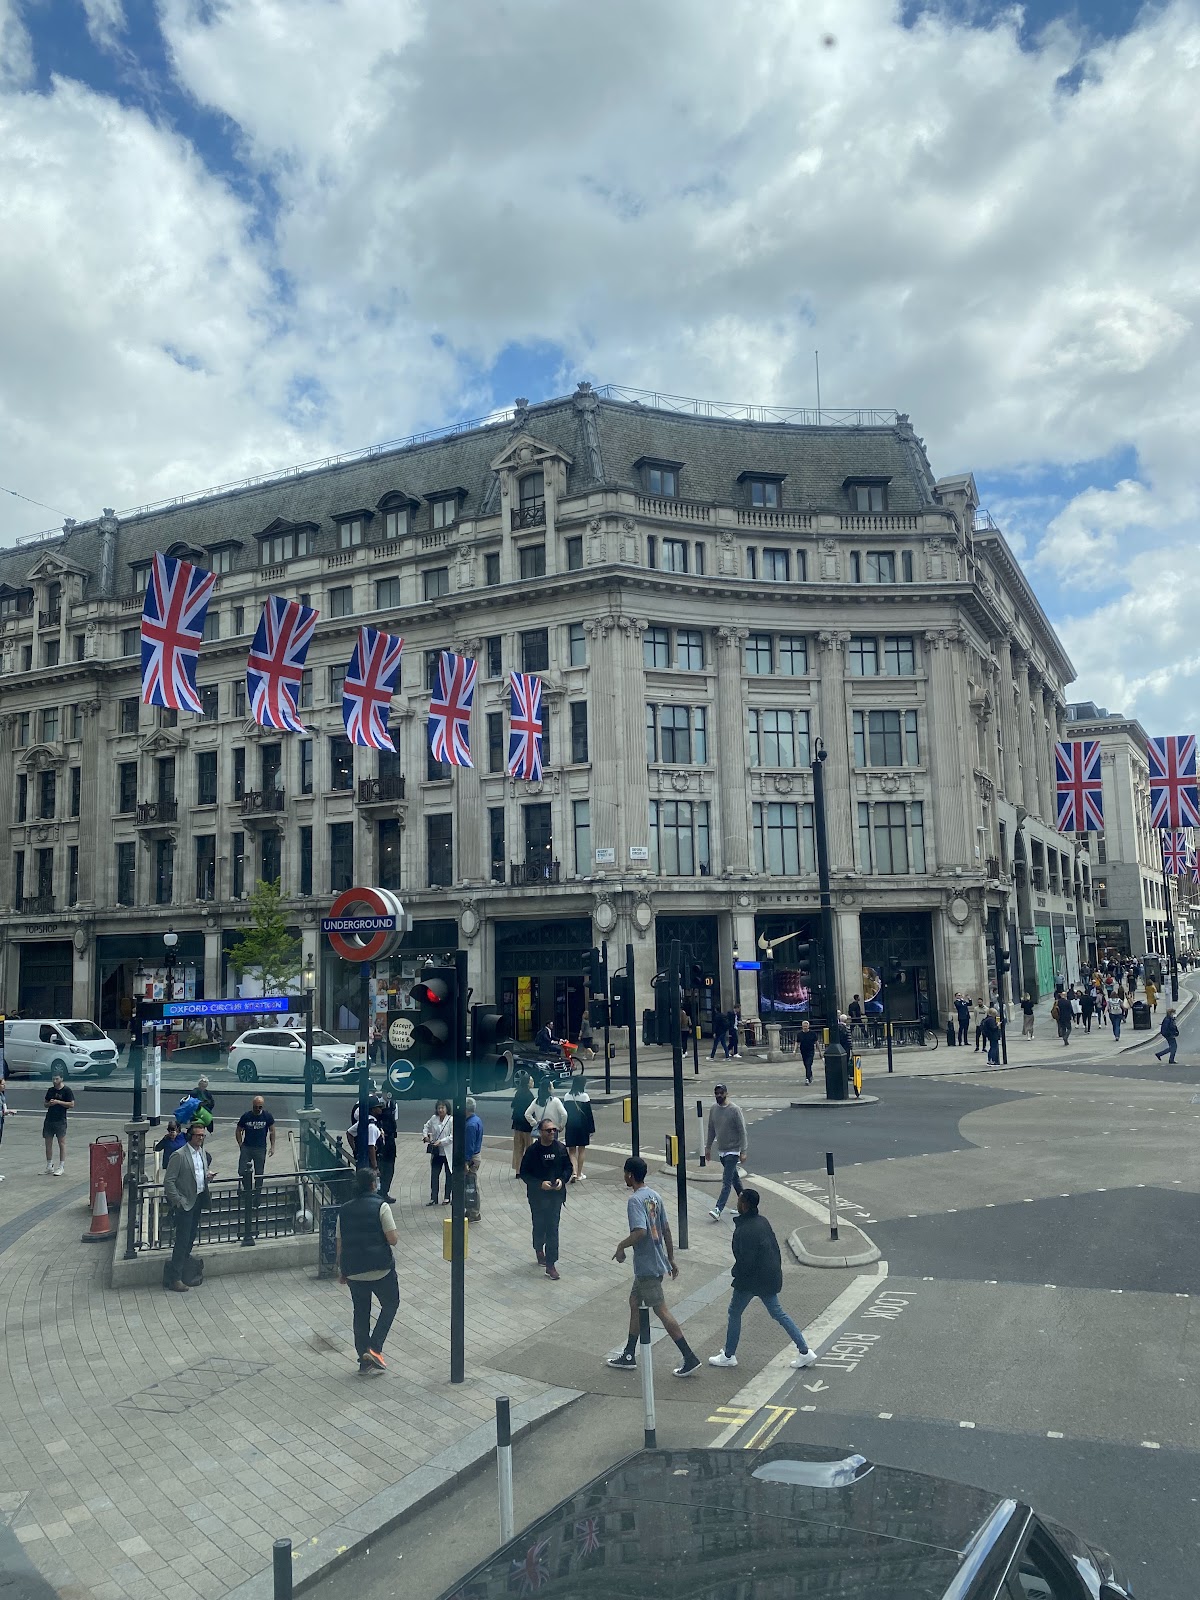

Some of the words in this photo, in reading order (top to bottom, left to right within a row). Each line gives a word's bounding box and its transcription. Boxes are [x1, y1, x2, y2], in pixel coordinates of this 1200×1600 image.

[25, 925, 58, 934] TOPSHOP
[323, 919, 393, 930] UNDERGROUND
[170, 1004, 208, 1014] OXFORD
[210, 1003, 242, 1012] CIRCUS
[860, 1291, 918, 1321] LOOK
[815, 1332, 881, 1373] RIGHT
